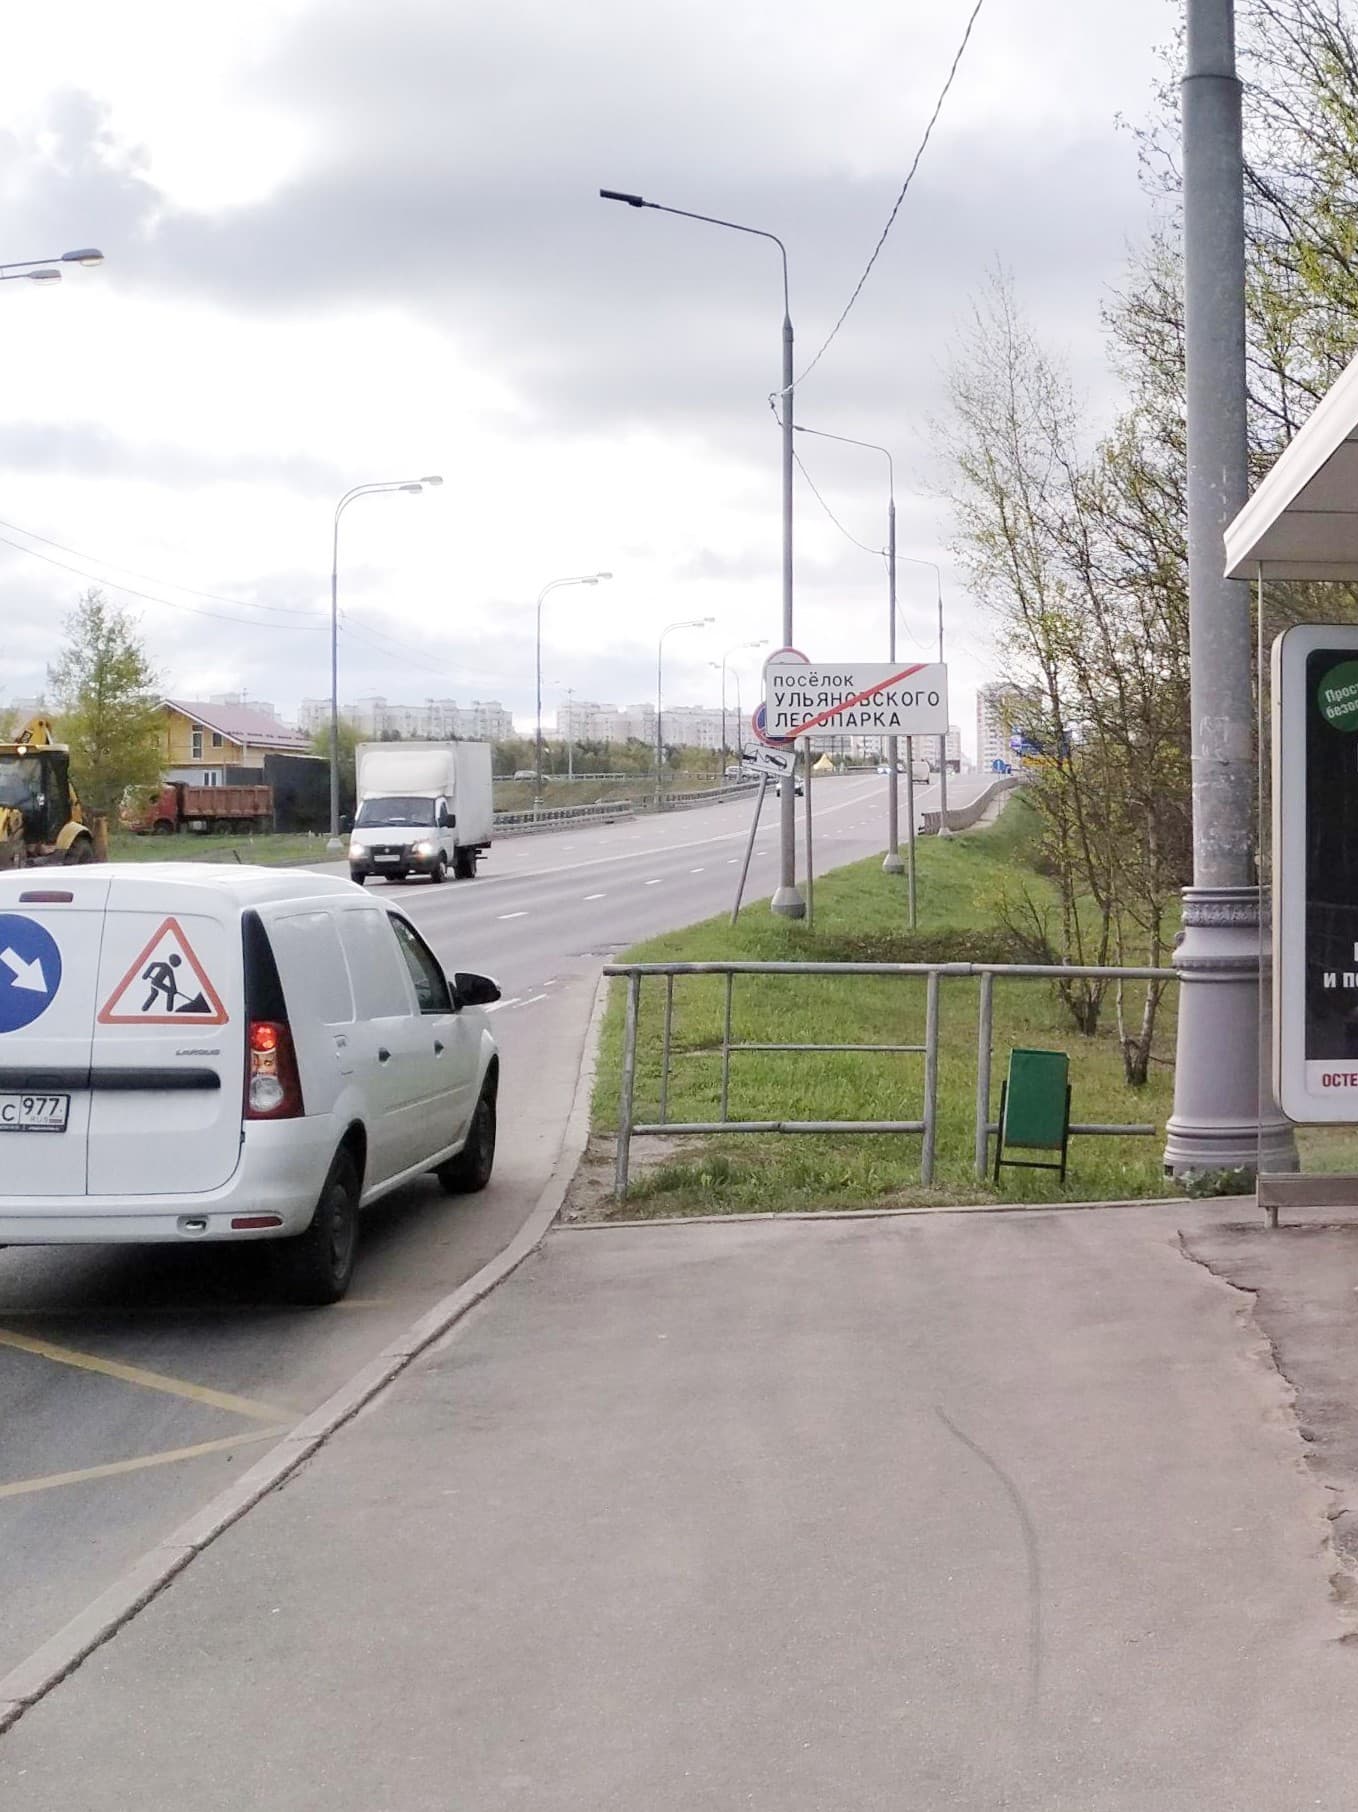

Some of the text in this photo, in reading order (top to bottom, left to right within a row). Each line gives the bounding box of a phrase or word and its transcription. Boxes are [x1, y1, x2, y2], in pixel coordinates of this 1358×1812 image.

[773, 671, 854, 688] посёлок
[775, 691, 940, 707] УЛЬЯНОВСКОГО
[775, 711, 901, 727] ЛЕСОПАРКА
[1323, 972, 1336, 988] и
[23, 1097, 60, 1116] 977
